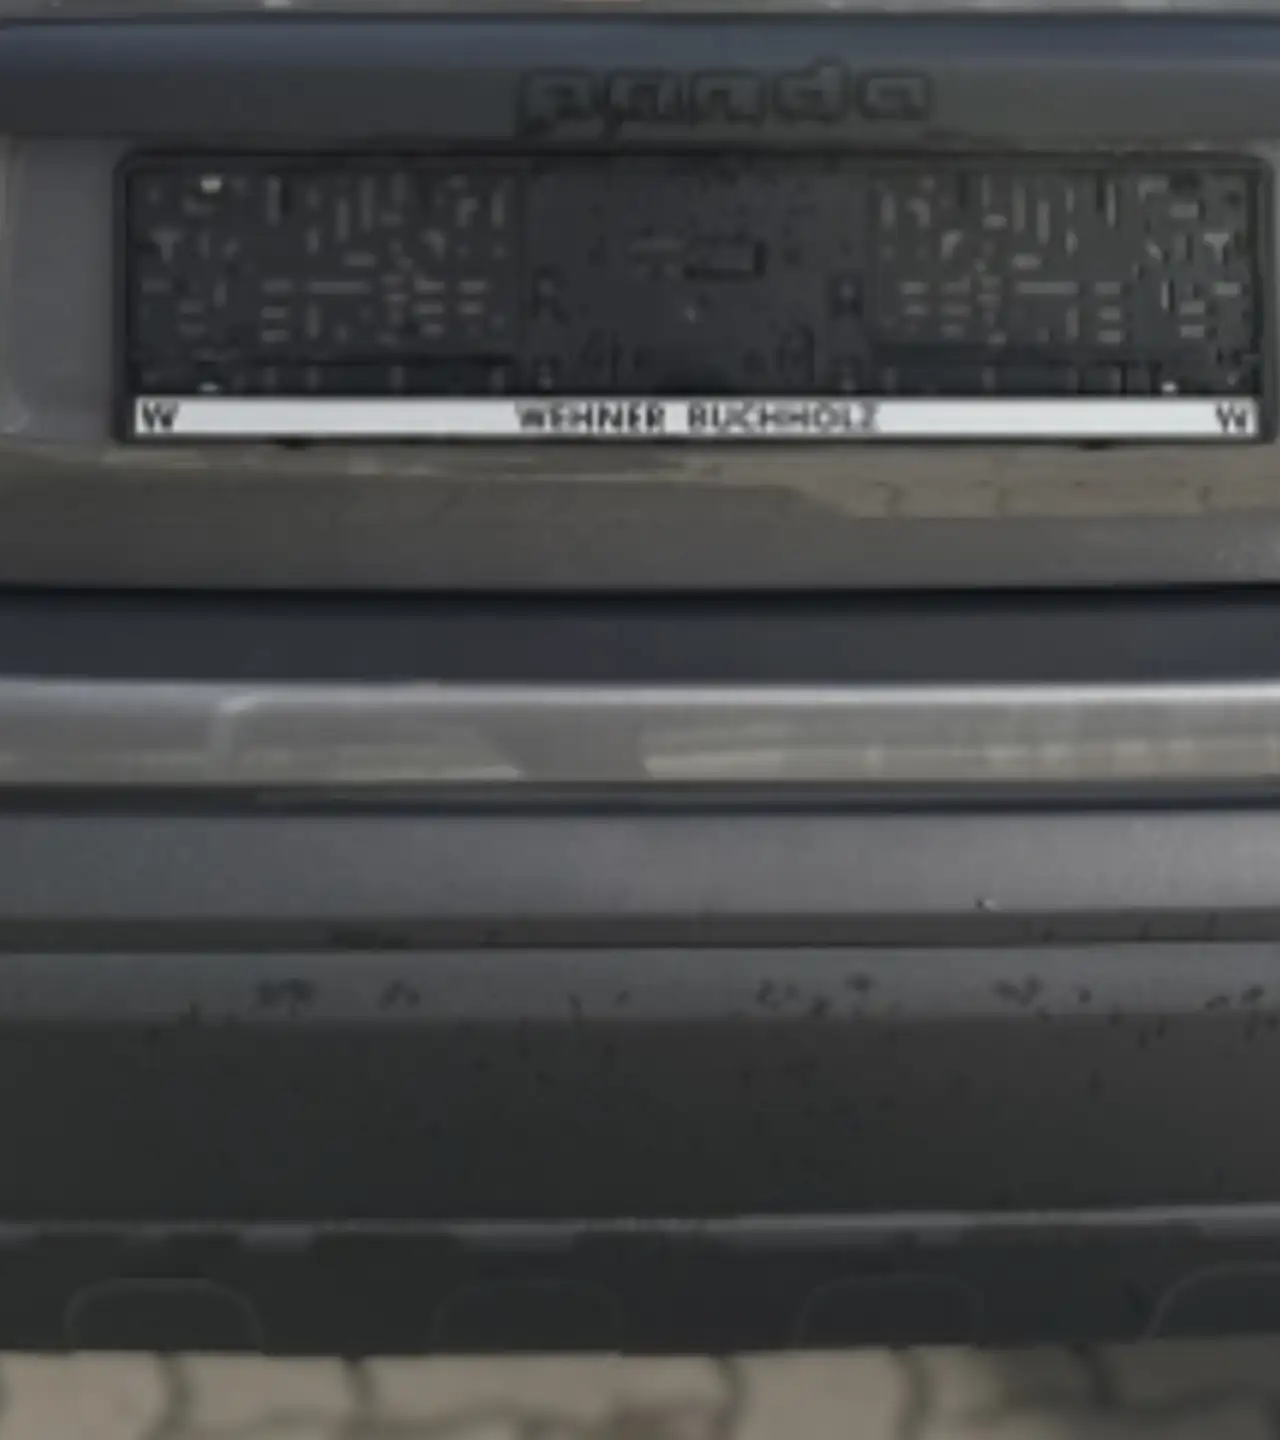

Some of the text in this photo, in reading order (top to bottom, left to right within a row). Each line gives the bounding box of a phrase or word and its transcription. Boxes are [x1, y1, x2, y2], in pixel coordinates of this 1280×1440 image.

[518, 60, 932, 140] panda
[141, 400, 180, 434] W
[515, 401, 878, 433] WEHNER BUCHHOLZ
[1215, 402, 1249, 434] W
